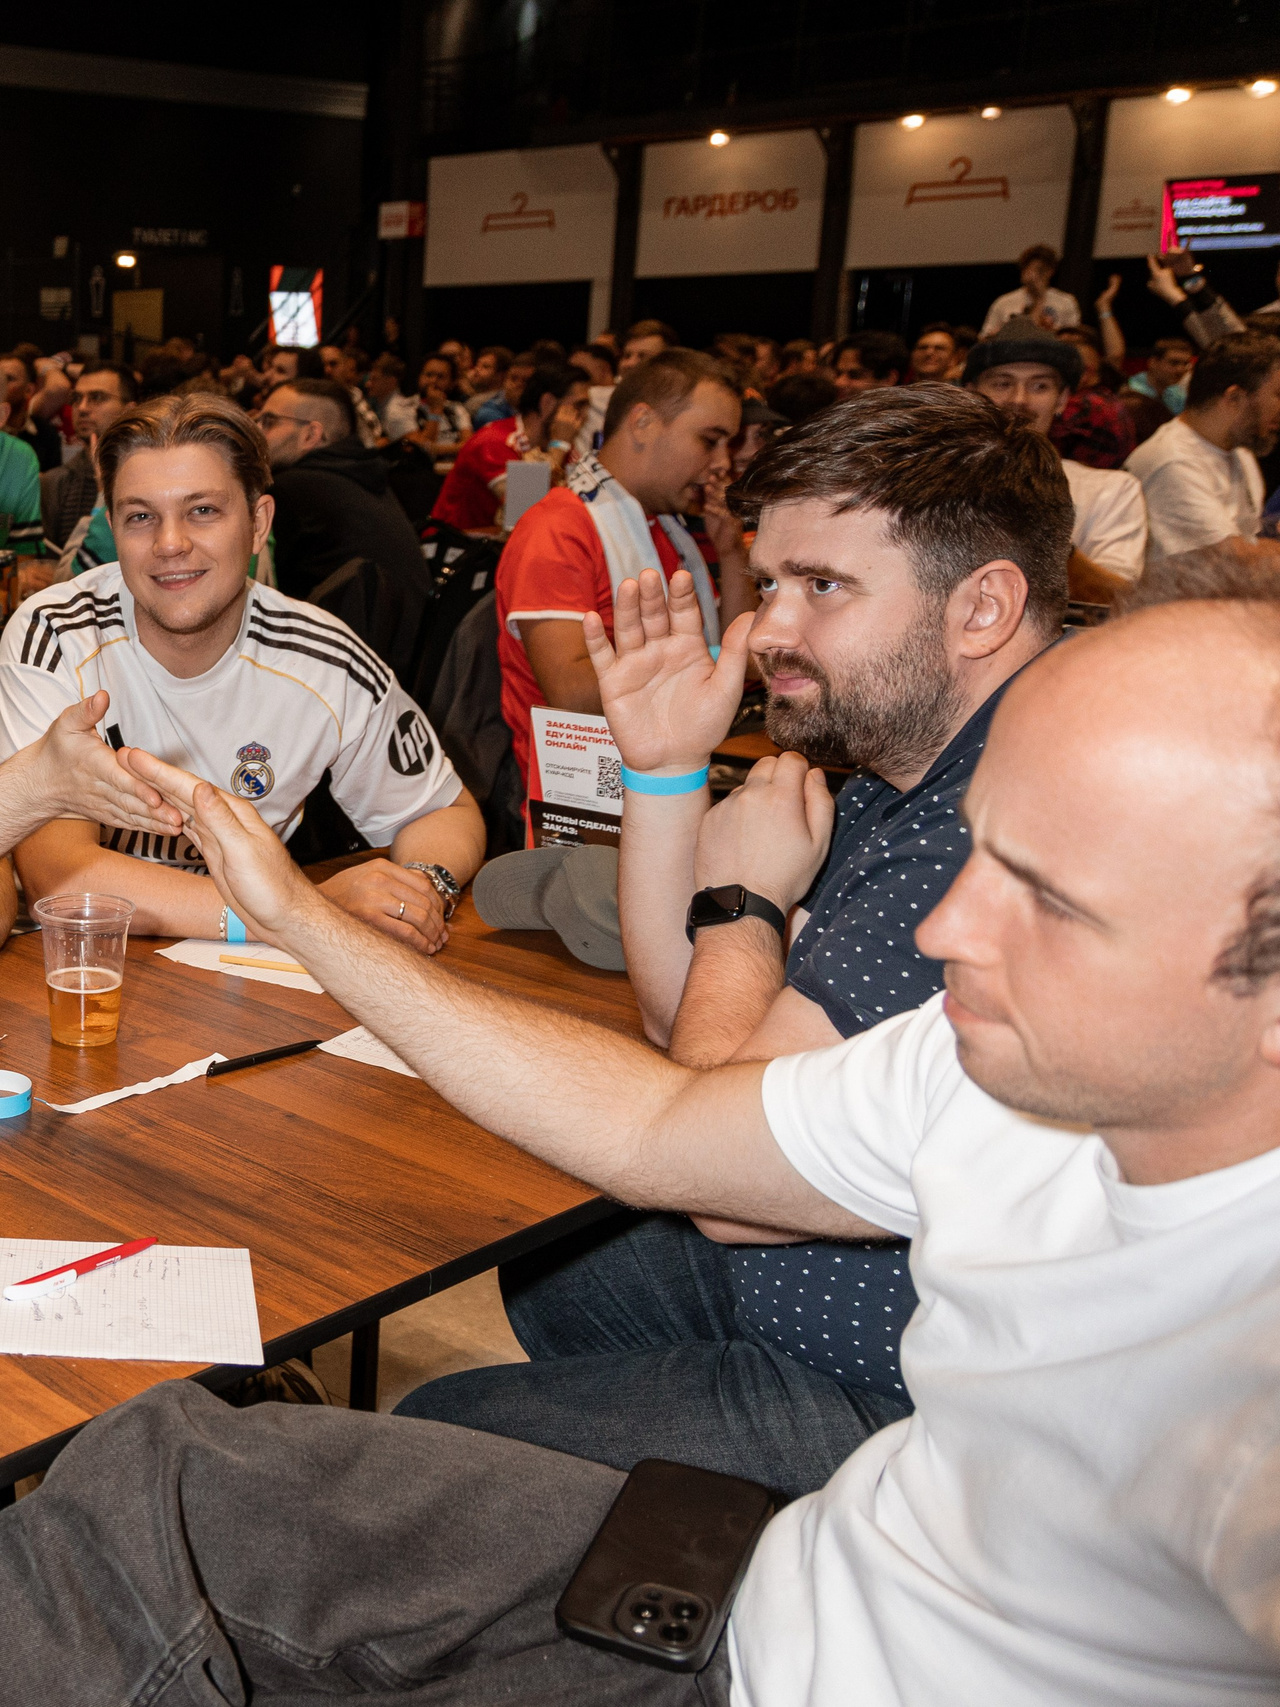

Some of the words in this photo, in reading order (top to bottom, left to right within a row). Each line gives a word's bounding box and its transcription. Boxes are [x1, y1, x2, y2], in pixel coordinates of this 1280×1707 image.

[663, 188, 799, 219] ГАРДЕРОБ
[546, 720, 611, 736] ЗАКАЗЫВАЙ
[394, 714, 430, 773] hp
[545, 730, 565, 739] ЕДУ
[574, 734, 616, 746] НАПИТК
[545, 739, 587, 751] ОНЛАЙН
[542, 812, 578, 826] ЧТОБЫ
[542, 822, 578, 836] ЗАКАЗ:
